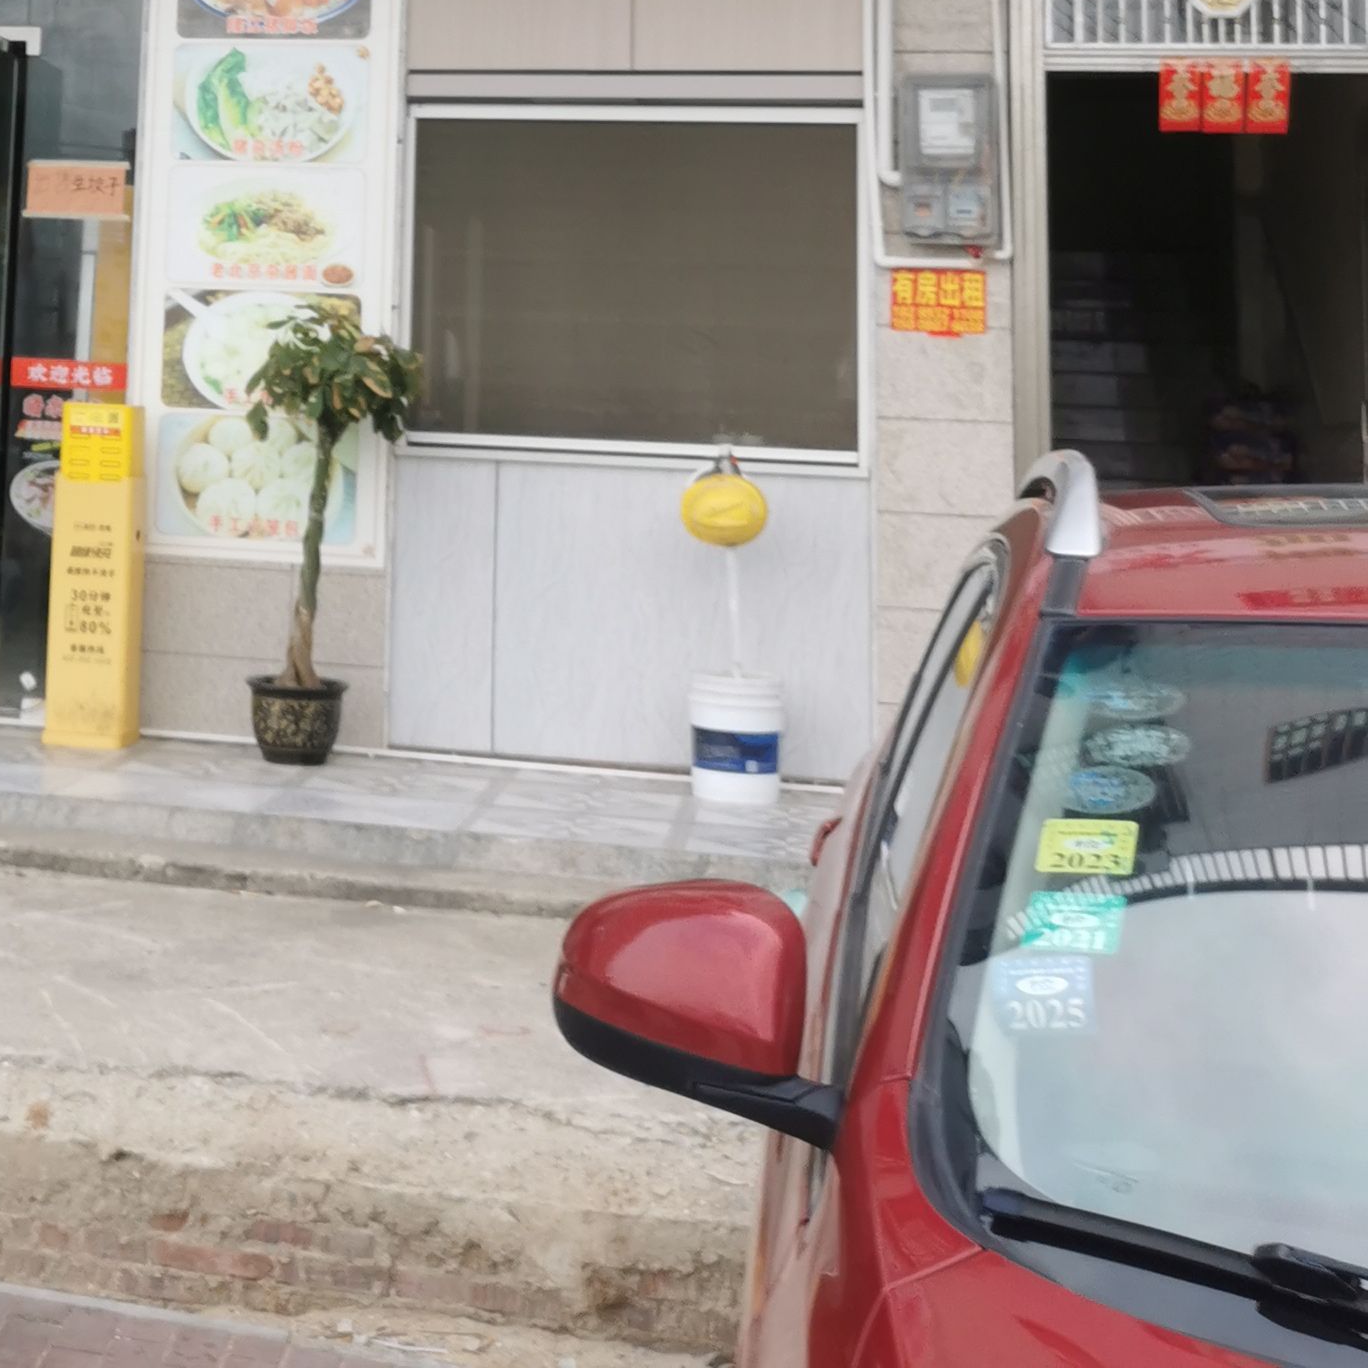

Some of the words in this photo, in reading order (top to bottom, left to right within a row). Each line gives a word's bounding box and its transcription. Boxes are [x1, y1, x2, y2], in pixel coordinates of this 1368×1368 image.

[27, 364, 113, 386] 欢迎光临
[1050, 852, 1124, 870] 2023
[1008, 998, 1086, 1029] 2025
